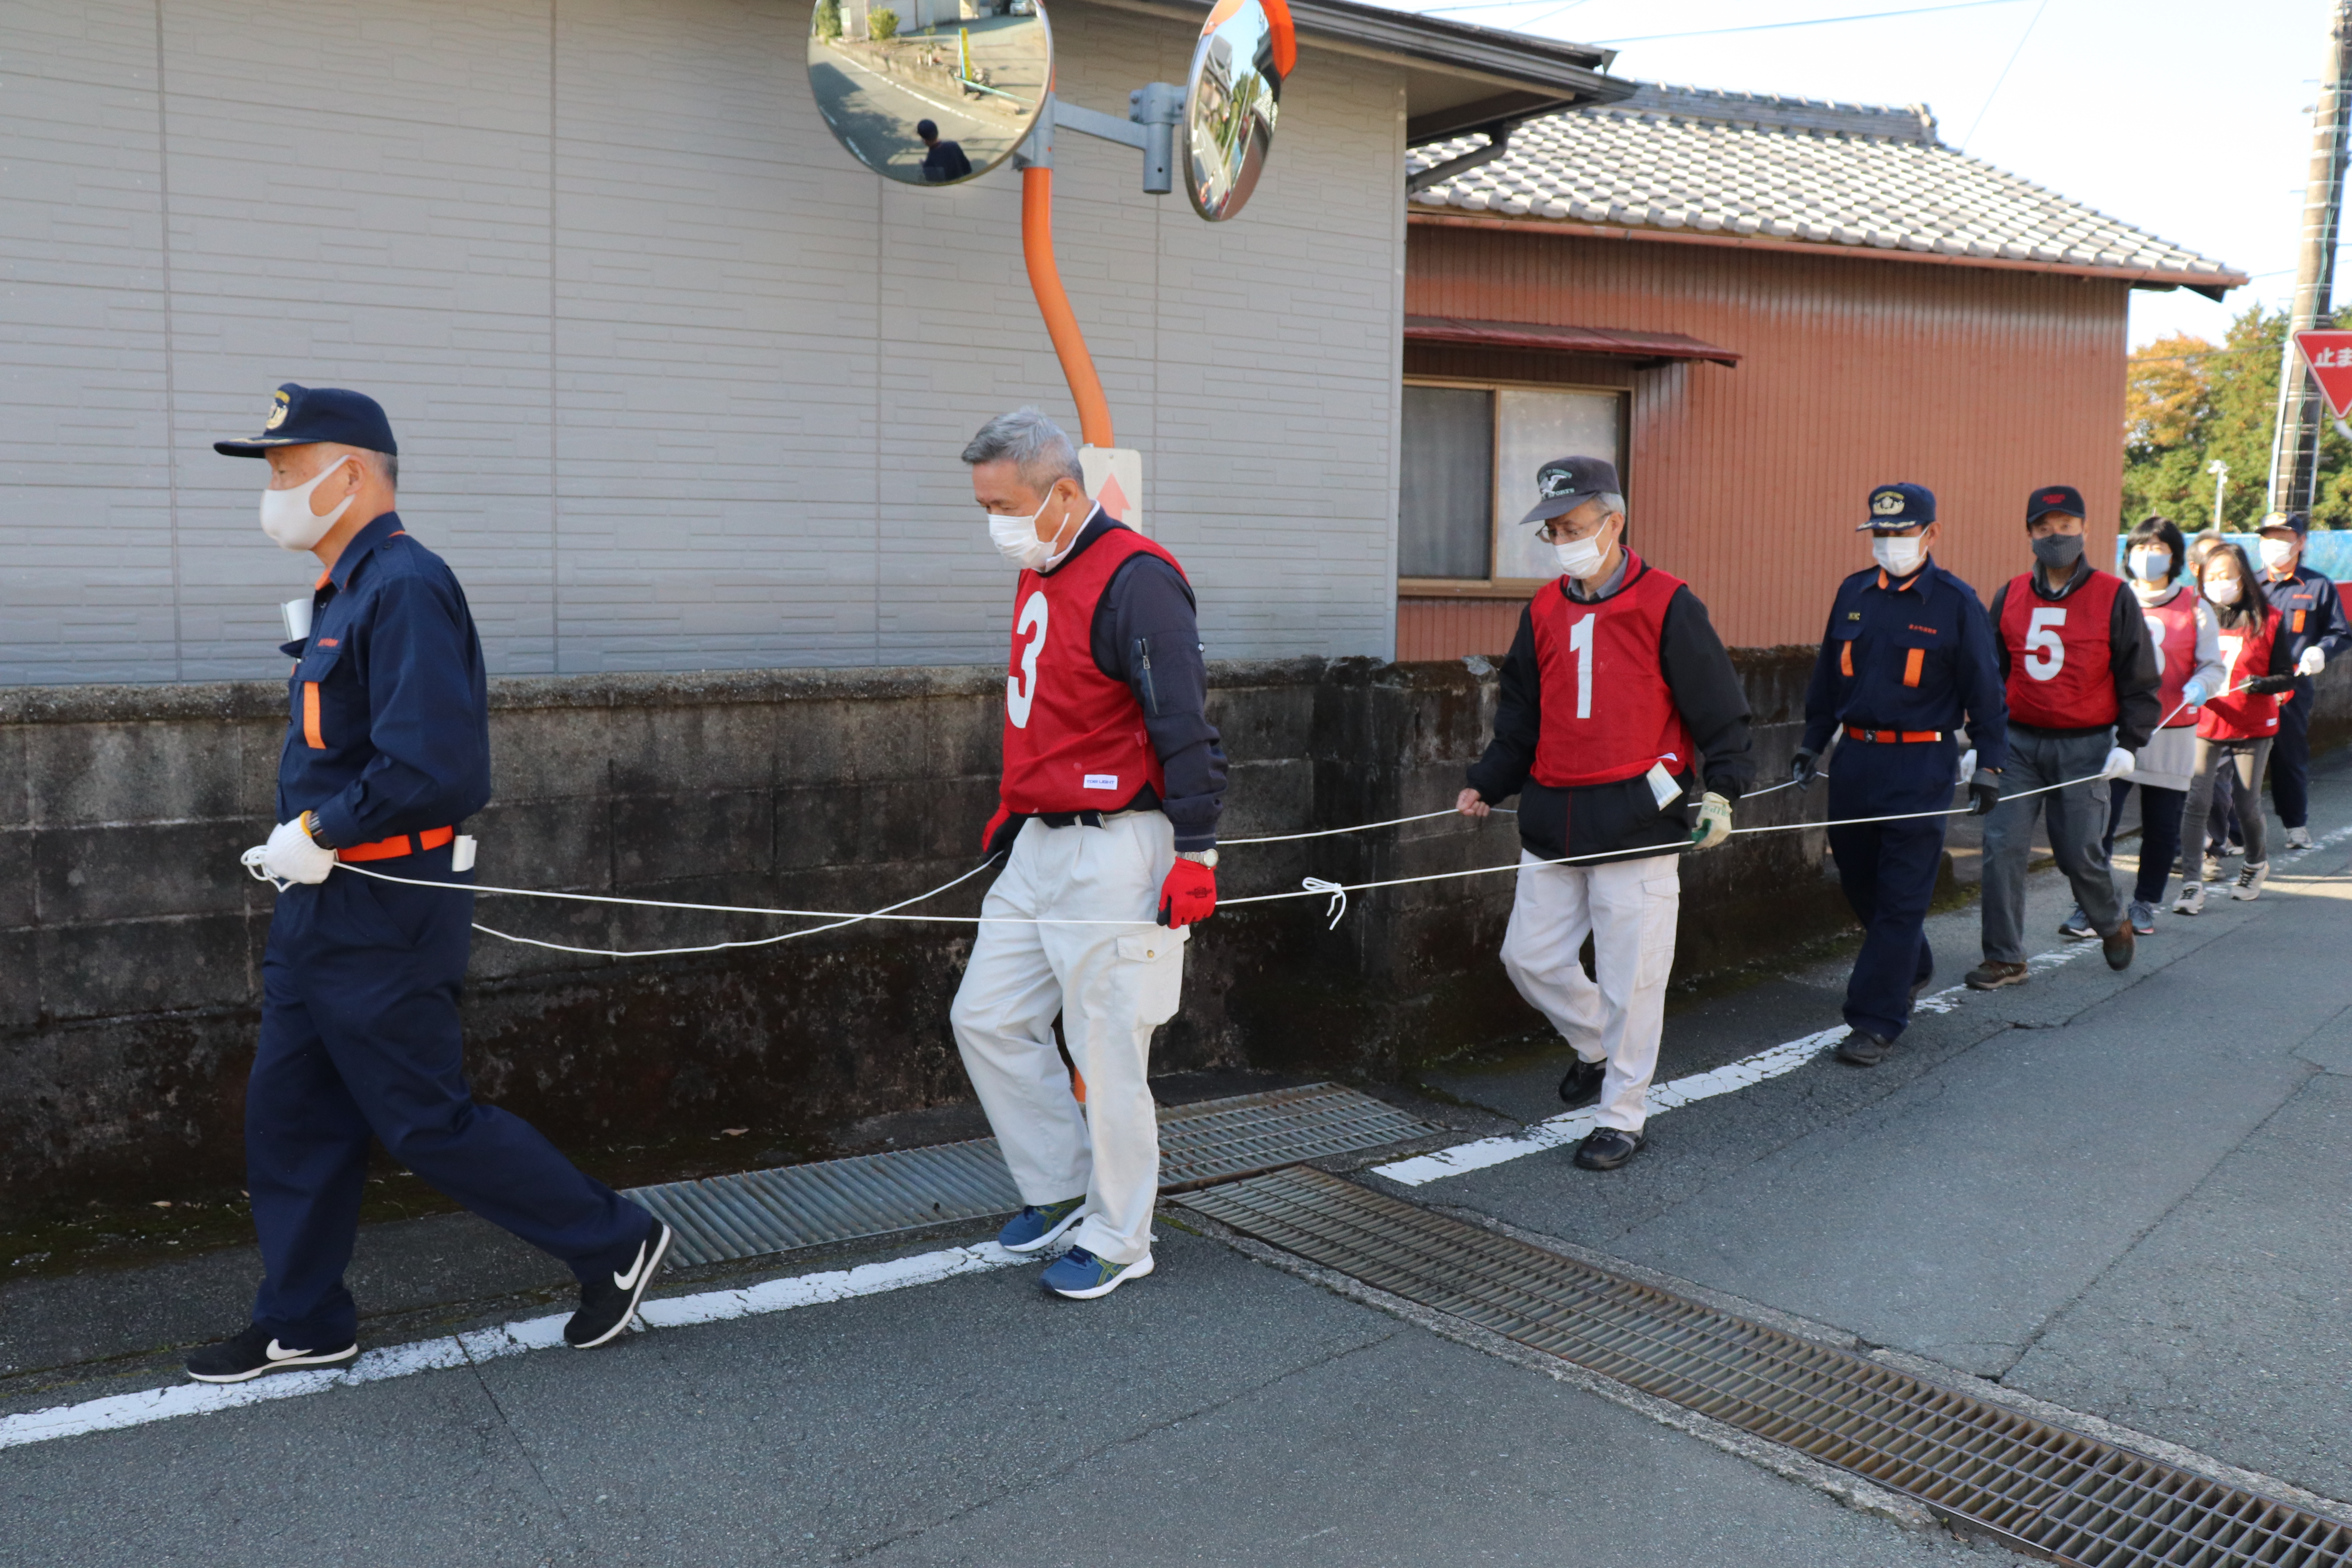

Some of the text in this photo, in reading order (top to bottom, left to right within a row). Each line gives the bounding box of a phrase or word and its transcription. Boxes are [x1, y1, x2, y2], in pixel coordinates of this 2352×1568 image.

[1007, 591, 1048, 728] 3
[1570, 613, 1595, 718] 1
[2025, 607, 2067, 681] 5
[2218, 635, 2243, 696] 7
